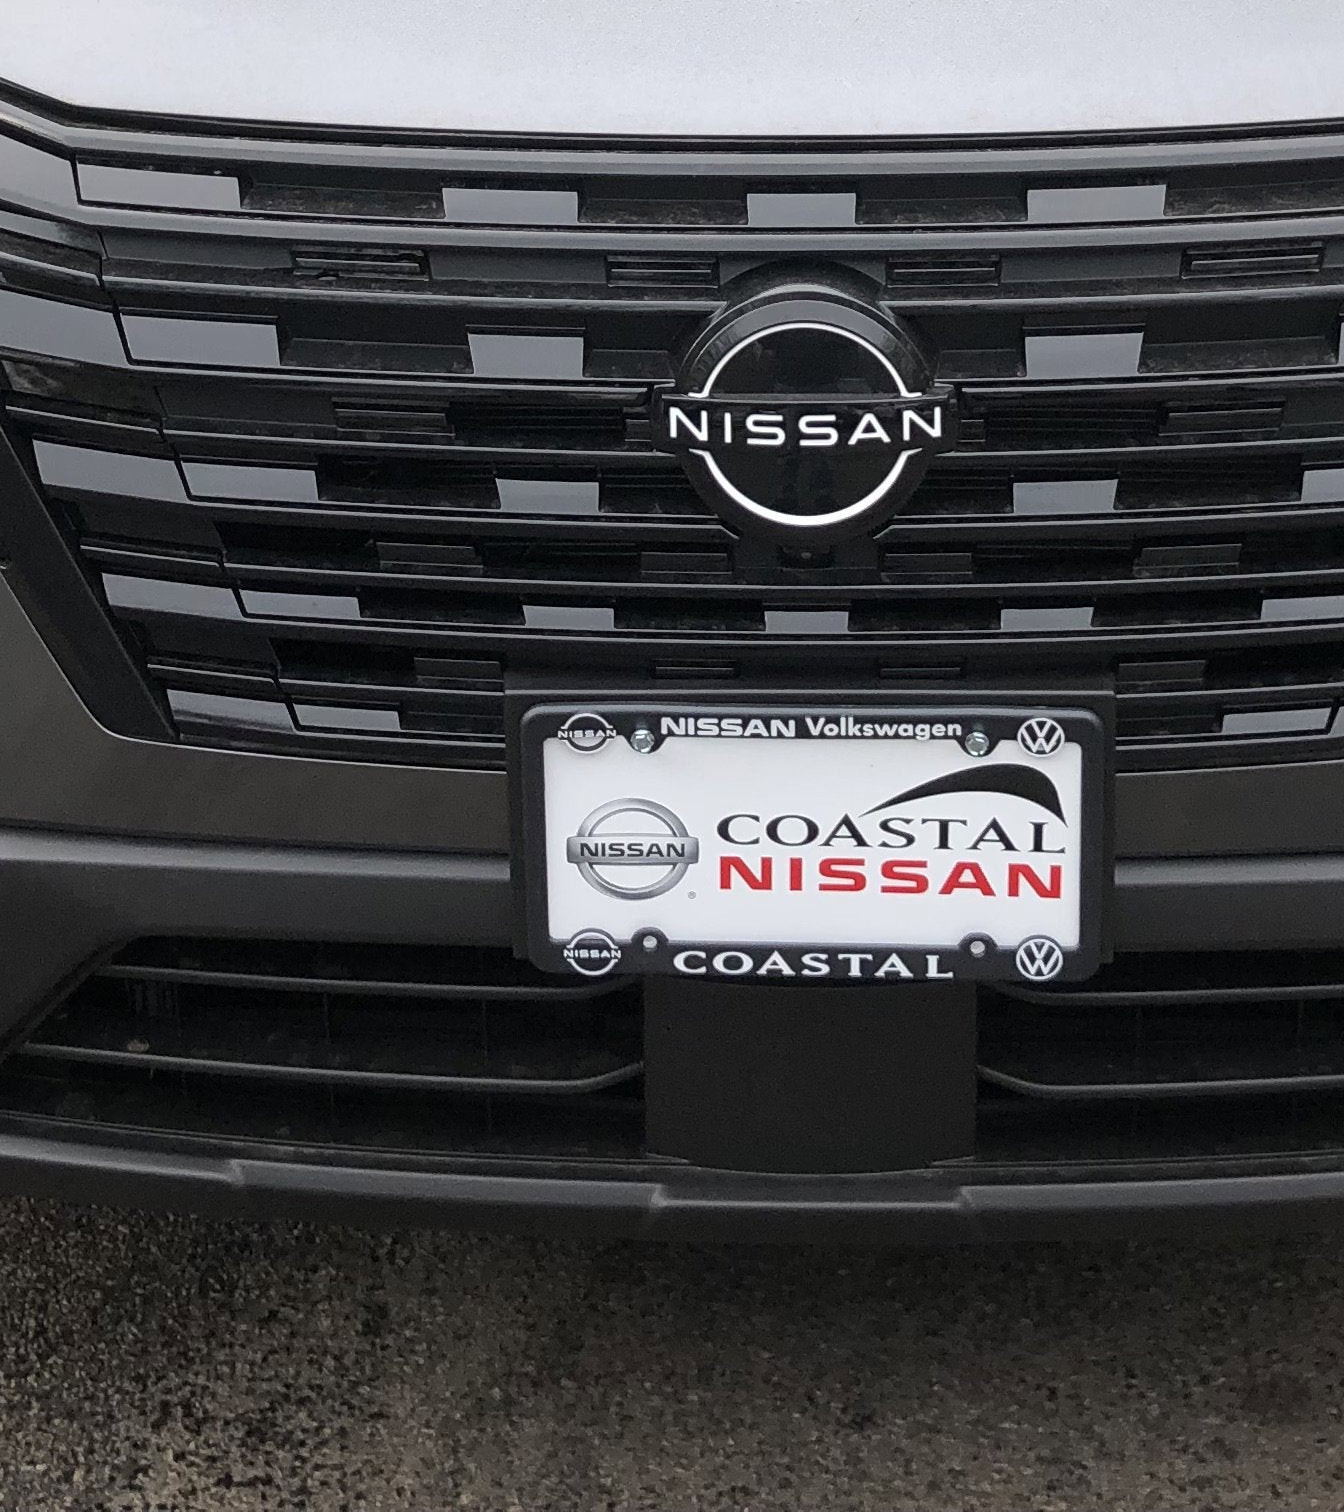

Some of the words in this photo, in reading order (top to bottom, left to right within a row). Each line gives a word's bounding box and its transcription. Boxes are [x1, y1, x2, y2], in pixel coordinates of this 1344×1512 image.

[669, 406, 942, 446] NISSAN
[557, 729, 616, 738] NISSAN
[660, 717, 796, 737] NISSAN
[805, 717, 962, 740] Volkswagen
[716, 813, 1066, 854] COASTAL
[579, 842, 685, 858] NISSAN
[718, 856, 1063, 899] NISSAN
[563, 949, 621, 959] NISSAN
[673, 950, 954, 979] COASTAL
